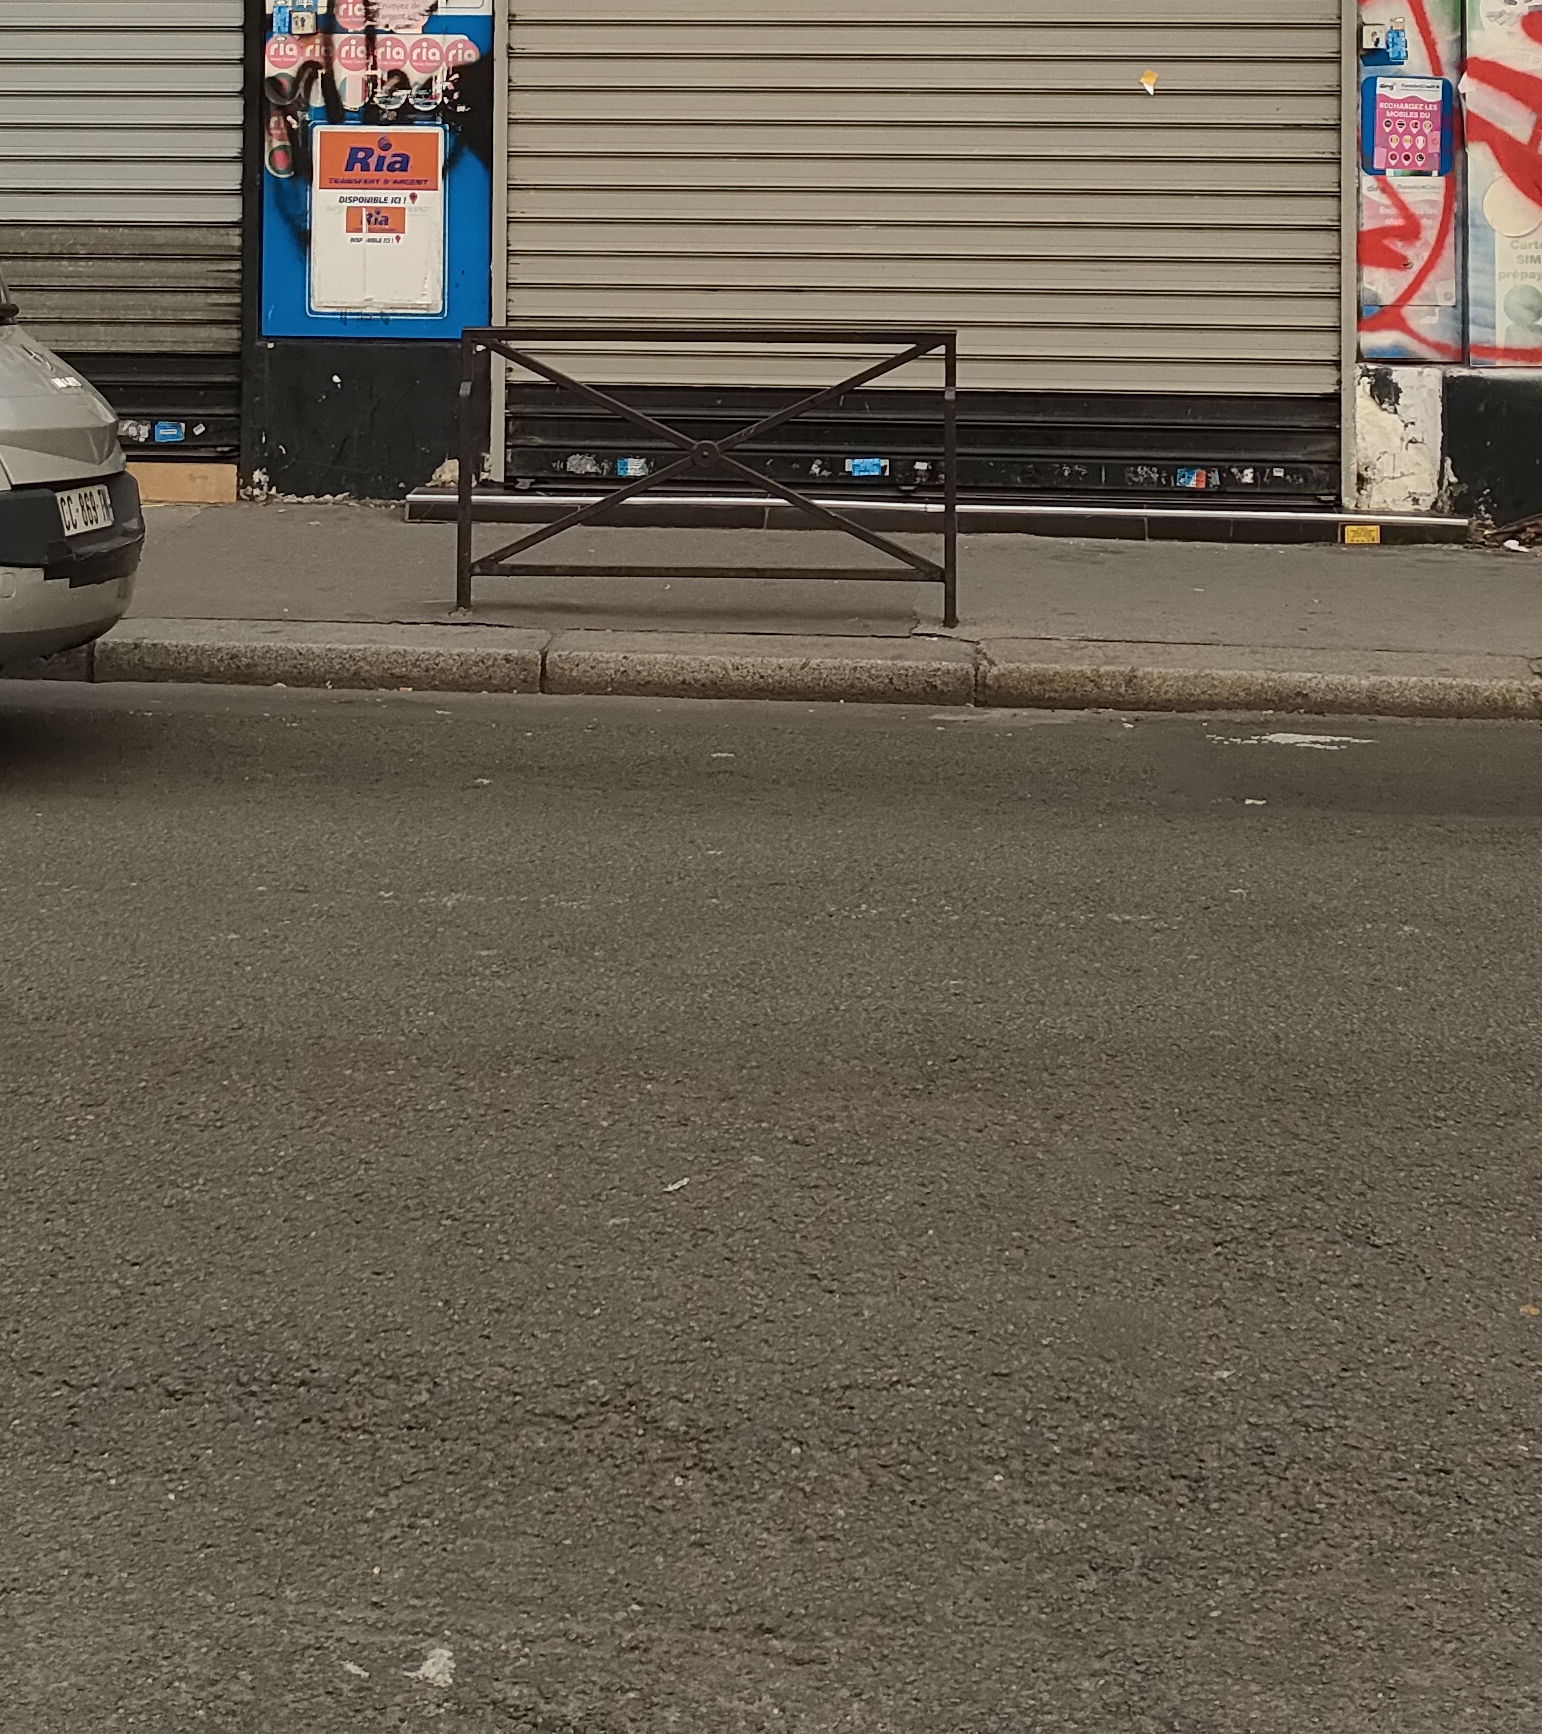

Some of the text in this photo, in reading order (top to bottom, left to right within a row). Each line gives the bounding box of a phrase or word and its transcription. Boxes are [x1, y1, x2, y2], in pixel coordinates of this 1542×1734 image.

[411, 41, 441, 60] ria
[448, 43, 477, 62] ria
[1379, 102, 1423, 110] RECHARGEZ
[344, 138, 410, 173] Ria
[339, 196, 388, 204] DISPONIBLE
[390, 196, 401, 204] ICI
[1516, 254, 1541, 265] SIM
